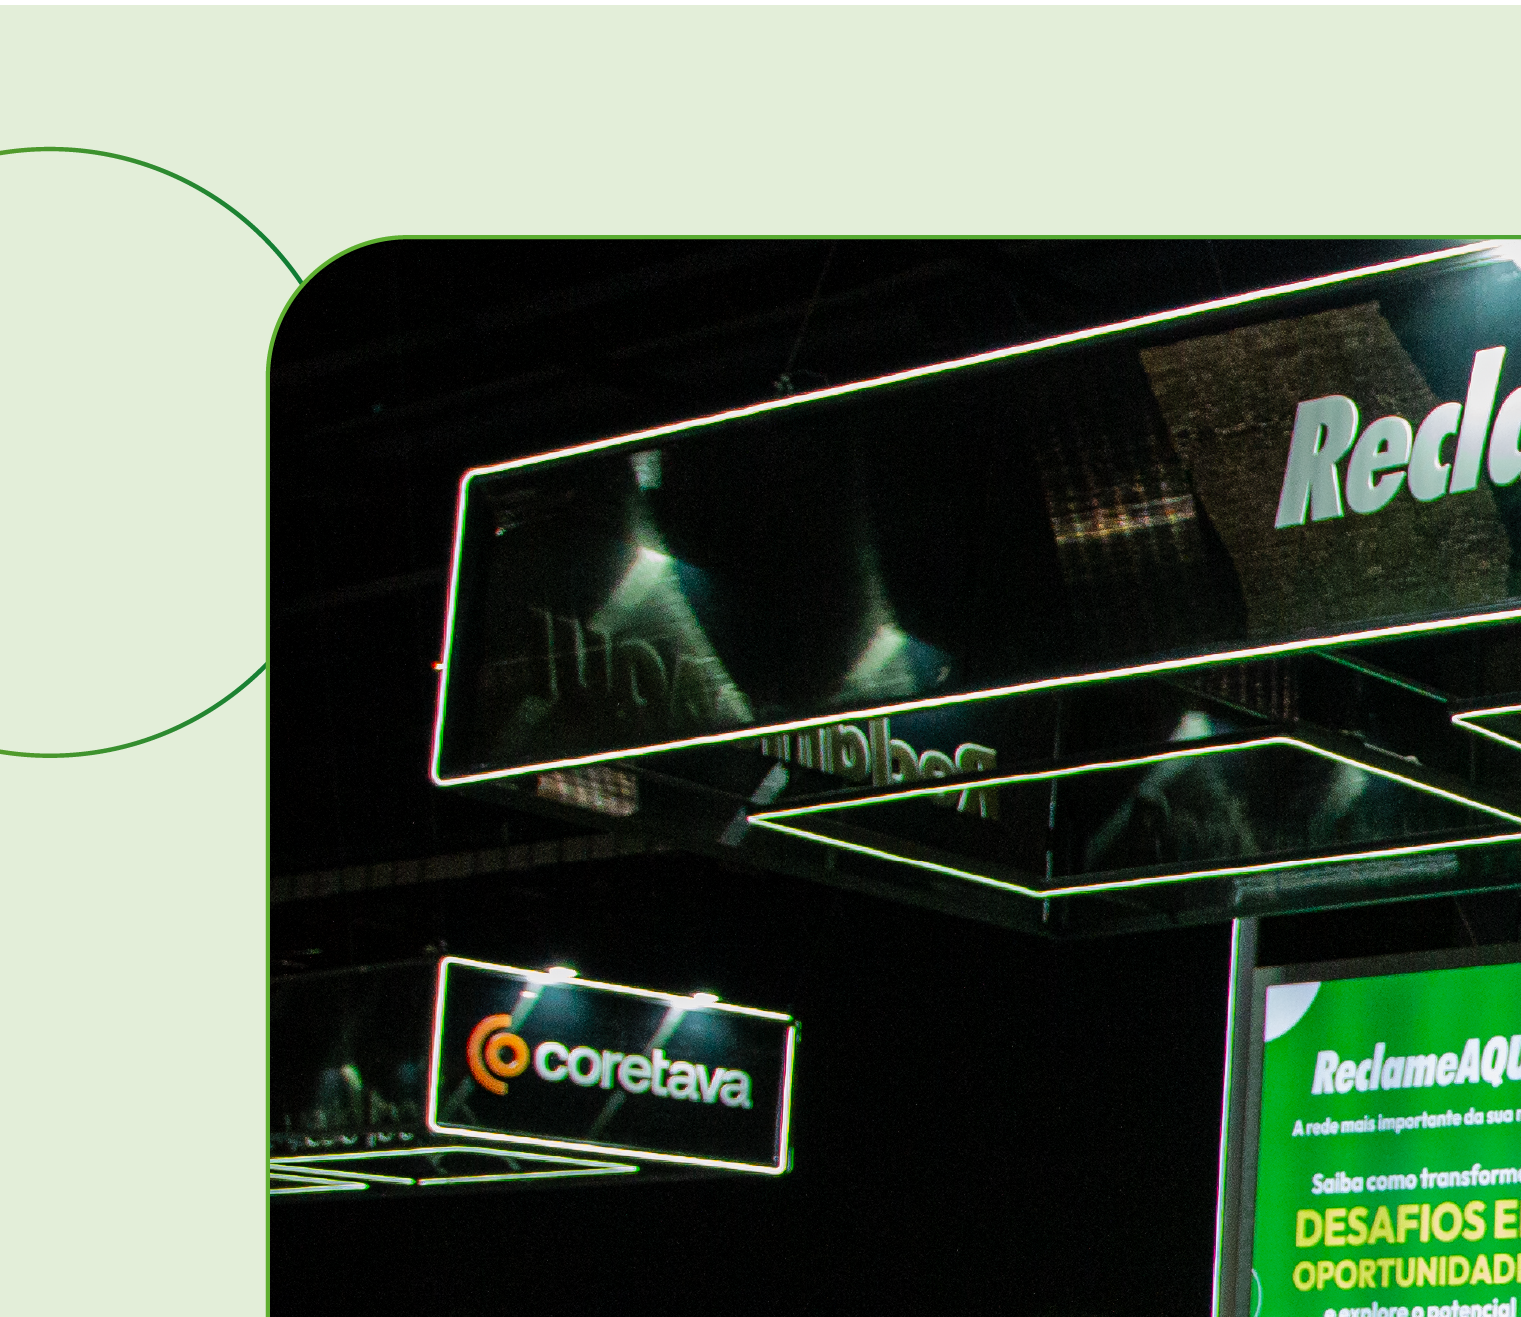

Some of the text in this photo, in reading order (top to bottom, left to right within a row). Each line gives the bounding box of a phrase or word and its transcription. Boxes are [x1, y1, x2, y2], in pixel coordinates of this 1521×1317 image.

[535, 1041, 753, 1109] coretava
[1292, 1119, 1304, 1137] A
[1306, 1117, 1339, 1136] rede
[1341, 1114, 1376, 1134] mais
[1378, 1110, 1461, 1134] importante
[1463, 1107, 1484, 1127] da
[1486, 1108, 1513, 1125] sua
[1312, 1171, 1364, 1195] Saiba
[1367, 1173, 1417, 1193] como
[1295, 1201, 1486, 1248] DESAFIOS
